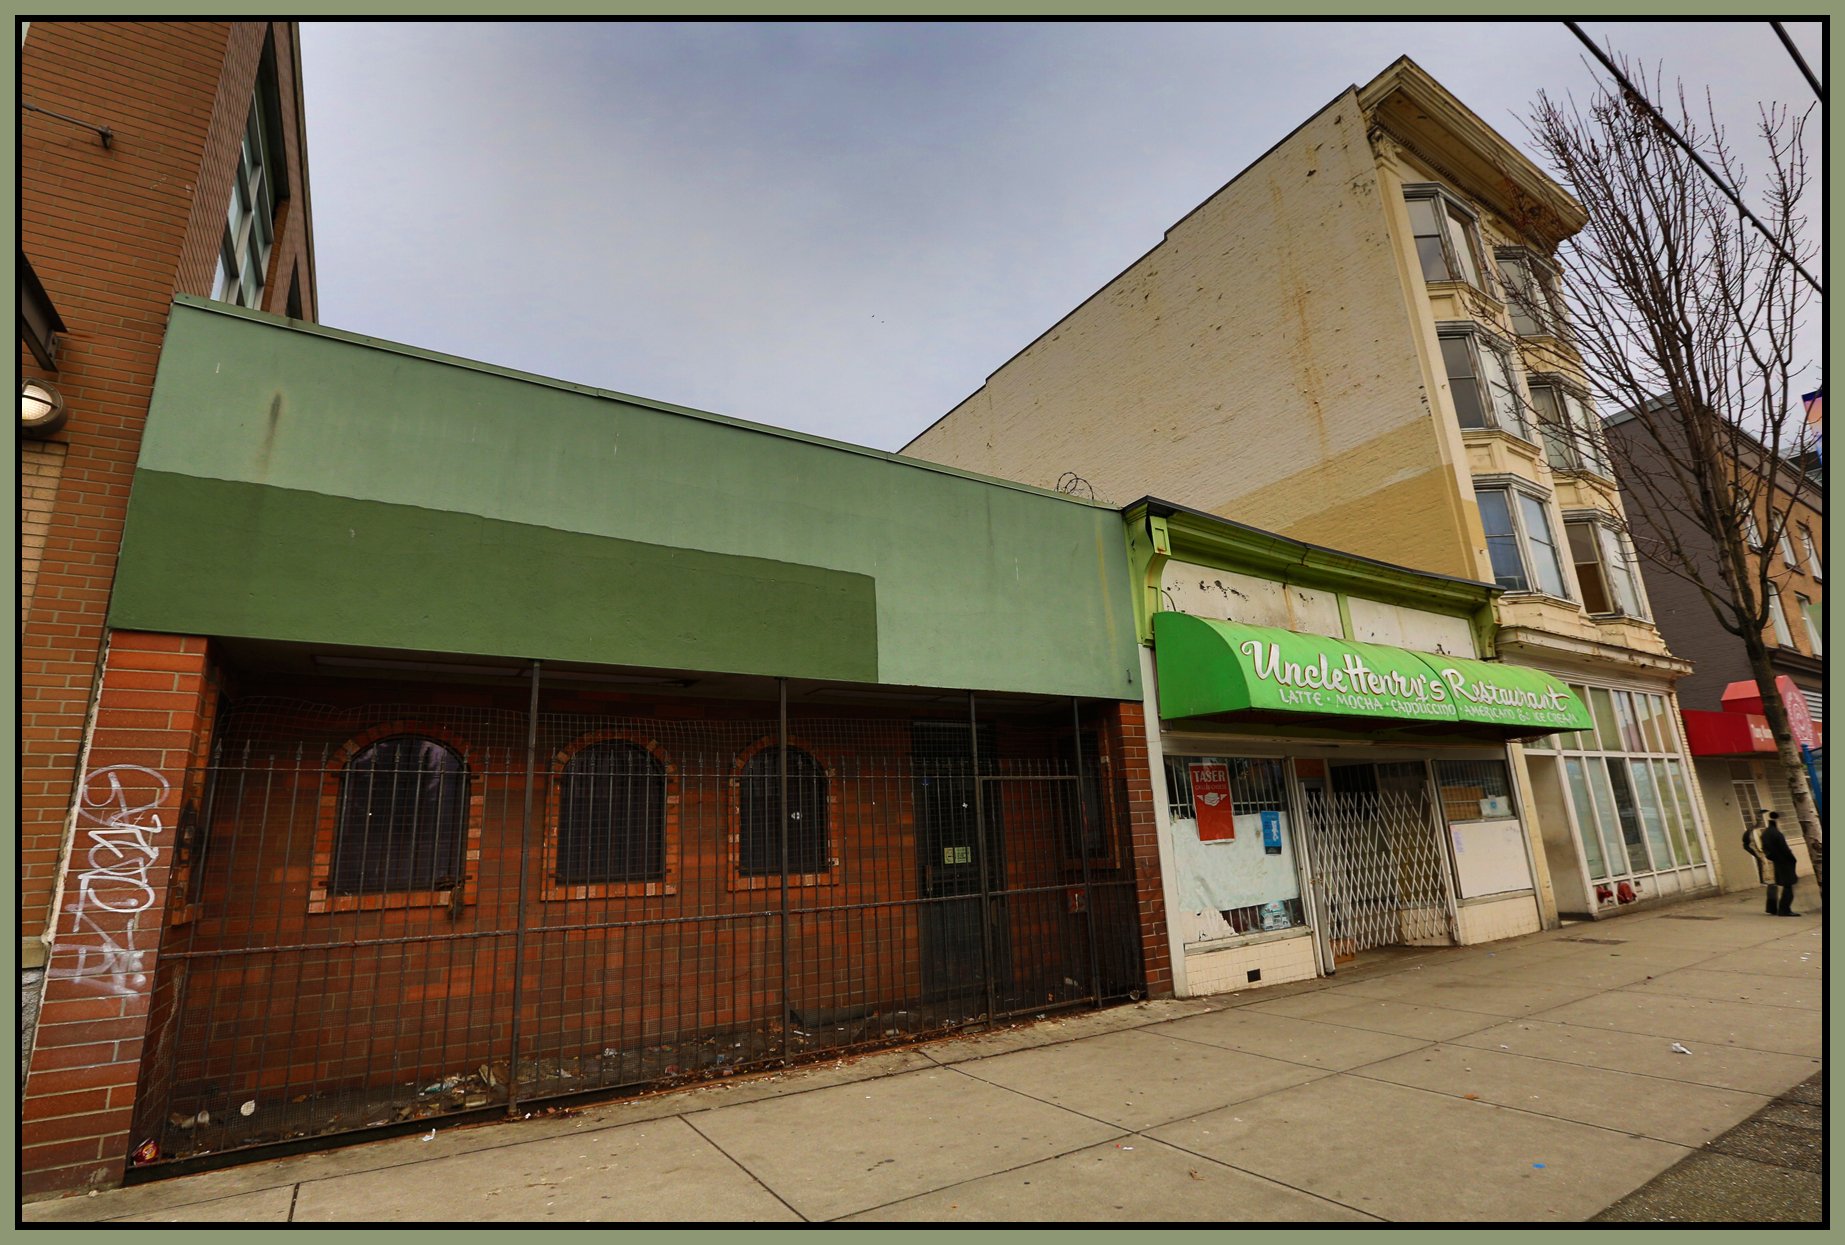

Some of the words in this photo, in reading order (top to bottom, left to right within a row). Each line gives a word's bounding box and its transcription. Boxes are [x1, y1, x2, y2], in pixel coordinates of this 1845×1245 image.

[1240, 640, 1348, 694] Uncle
[1341, 653, 1446, 704] Henry's
[1442, 668, 1572, 712] Restaurant
[1279, 688, 1324, 706] LATTE
[1336, 694, 1384, 712] MOCHA
[1517, 708, 1531, 722] &
[1546, 711, 1578, 726] CREAM
[1193, 770, 1226, 783] TASER
